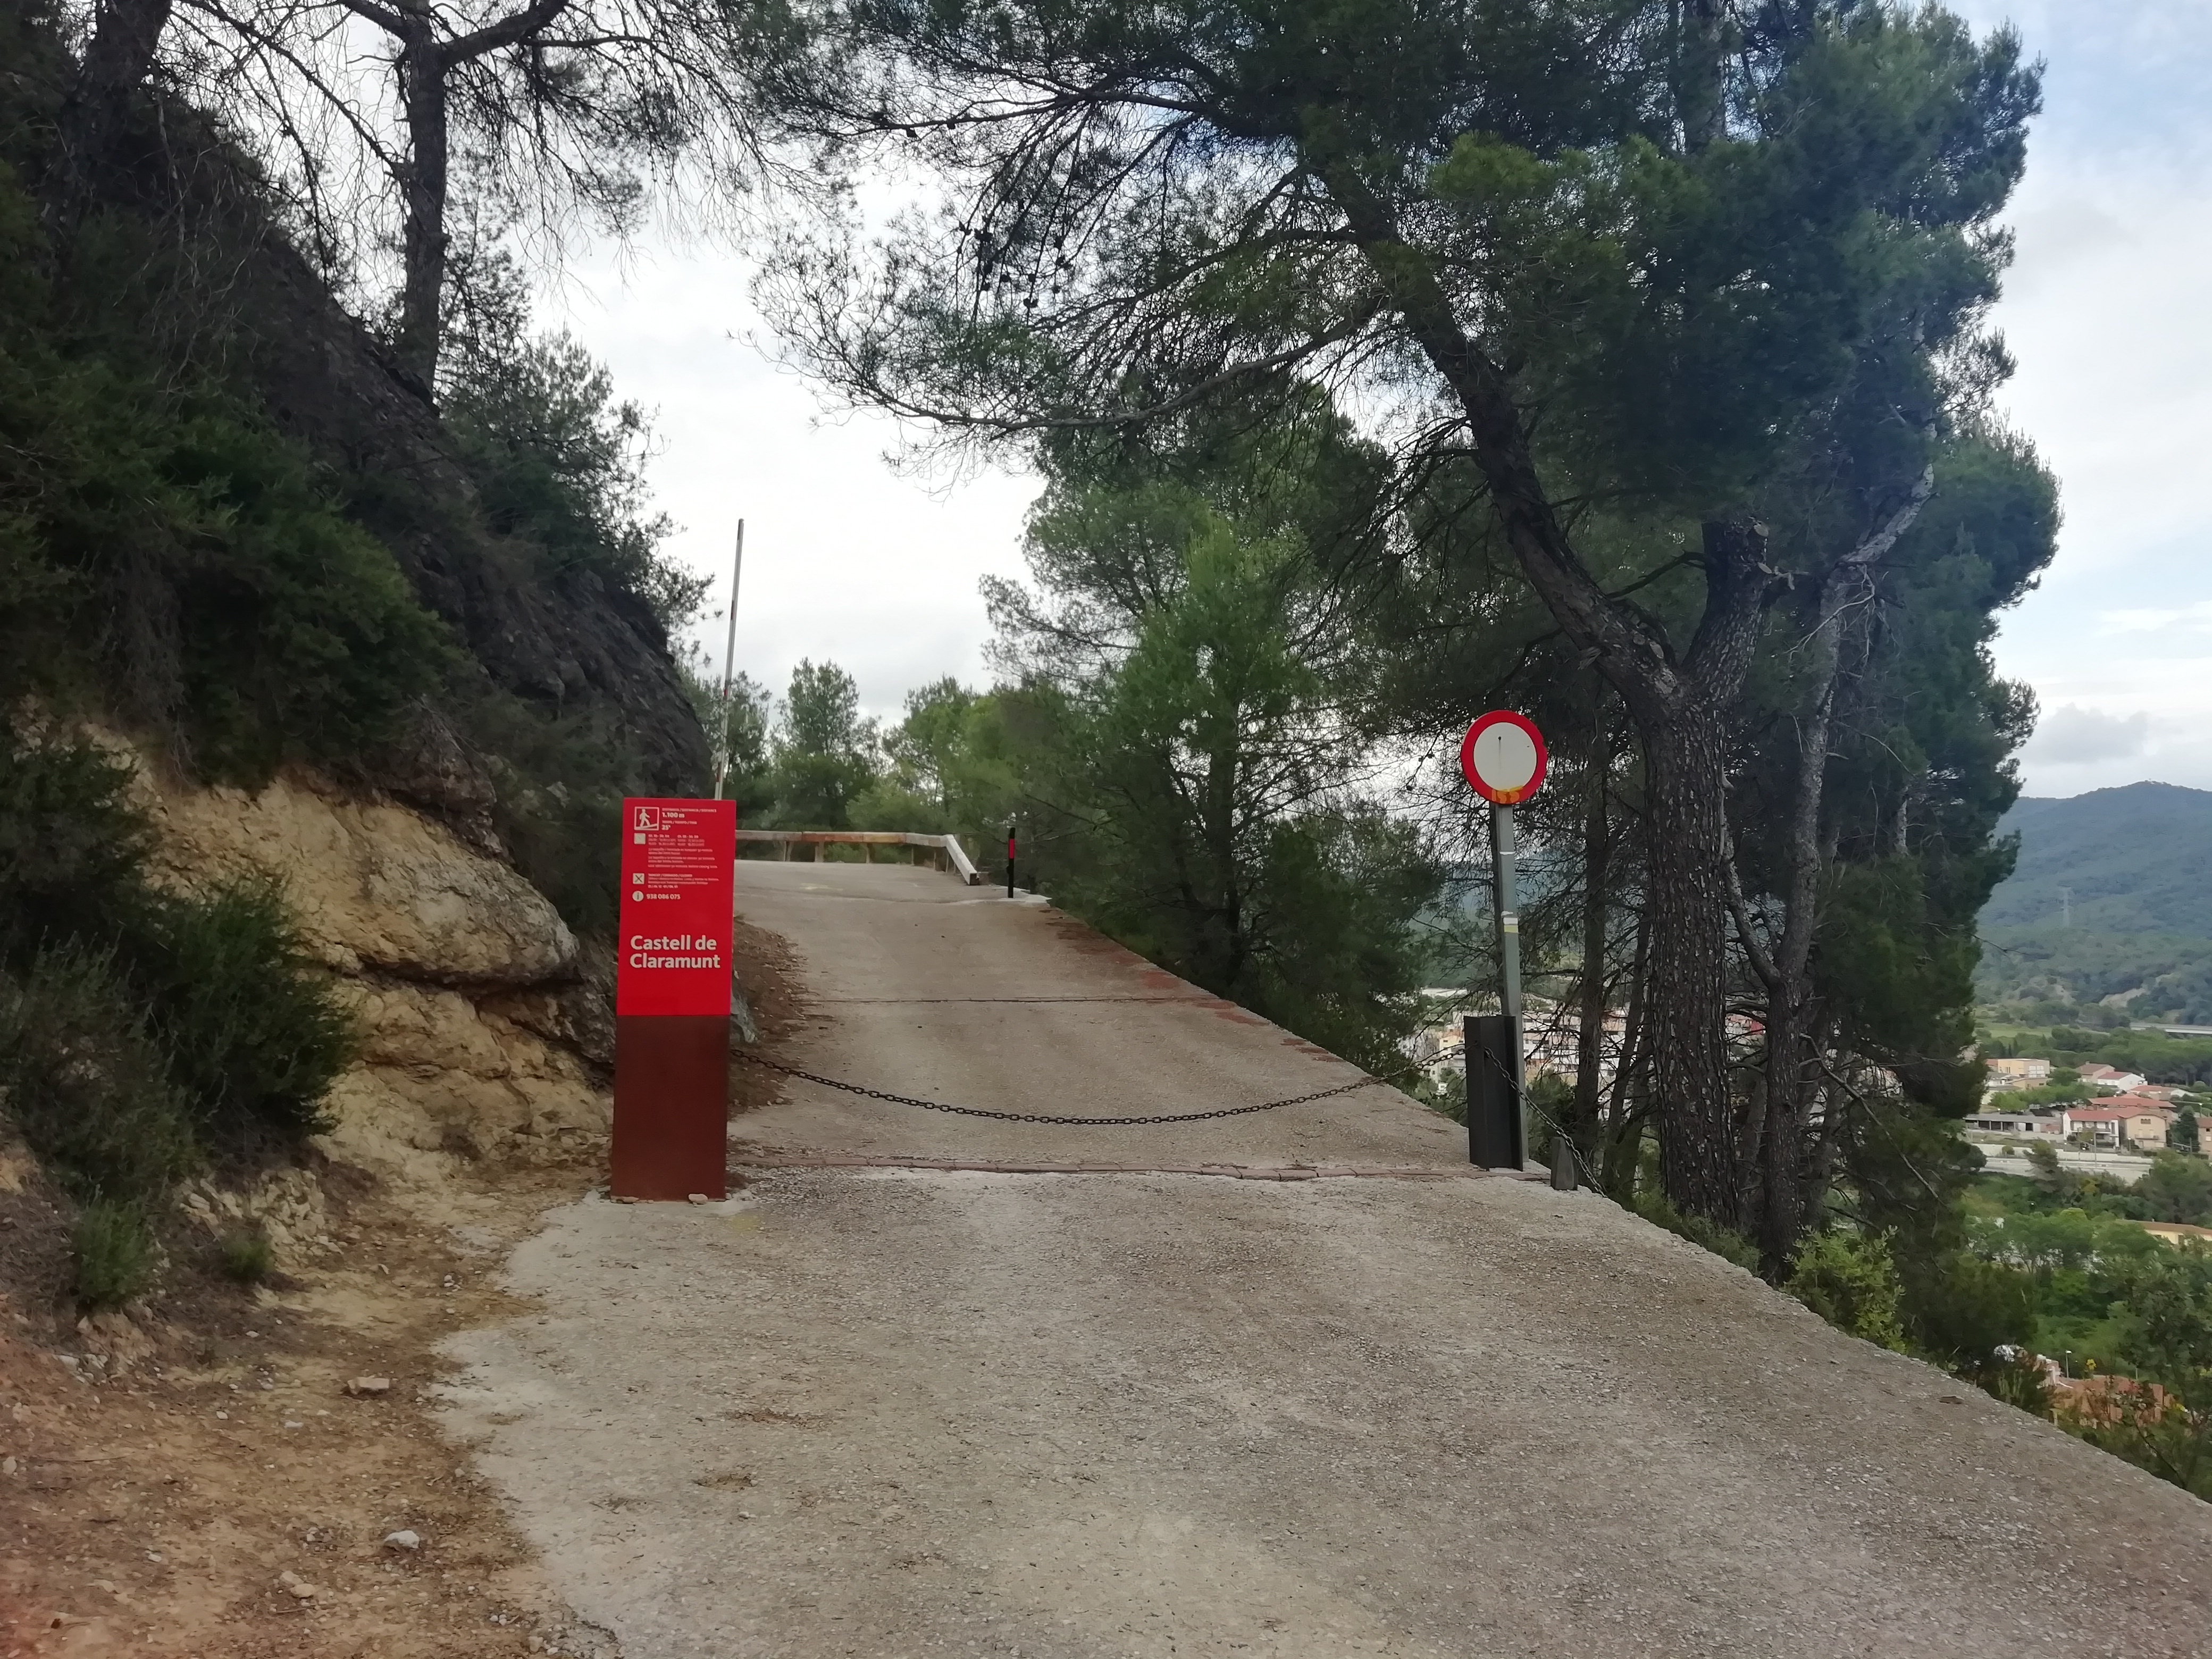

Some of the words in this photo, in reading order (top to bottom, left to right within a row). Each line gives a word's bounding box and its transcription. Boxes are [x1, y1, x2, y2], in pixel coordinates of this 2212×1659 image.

[630, 934, 691, 951] Castell
[694, 934, 717, 951] de
[630, 952, 721, 969] Claramunt
